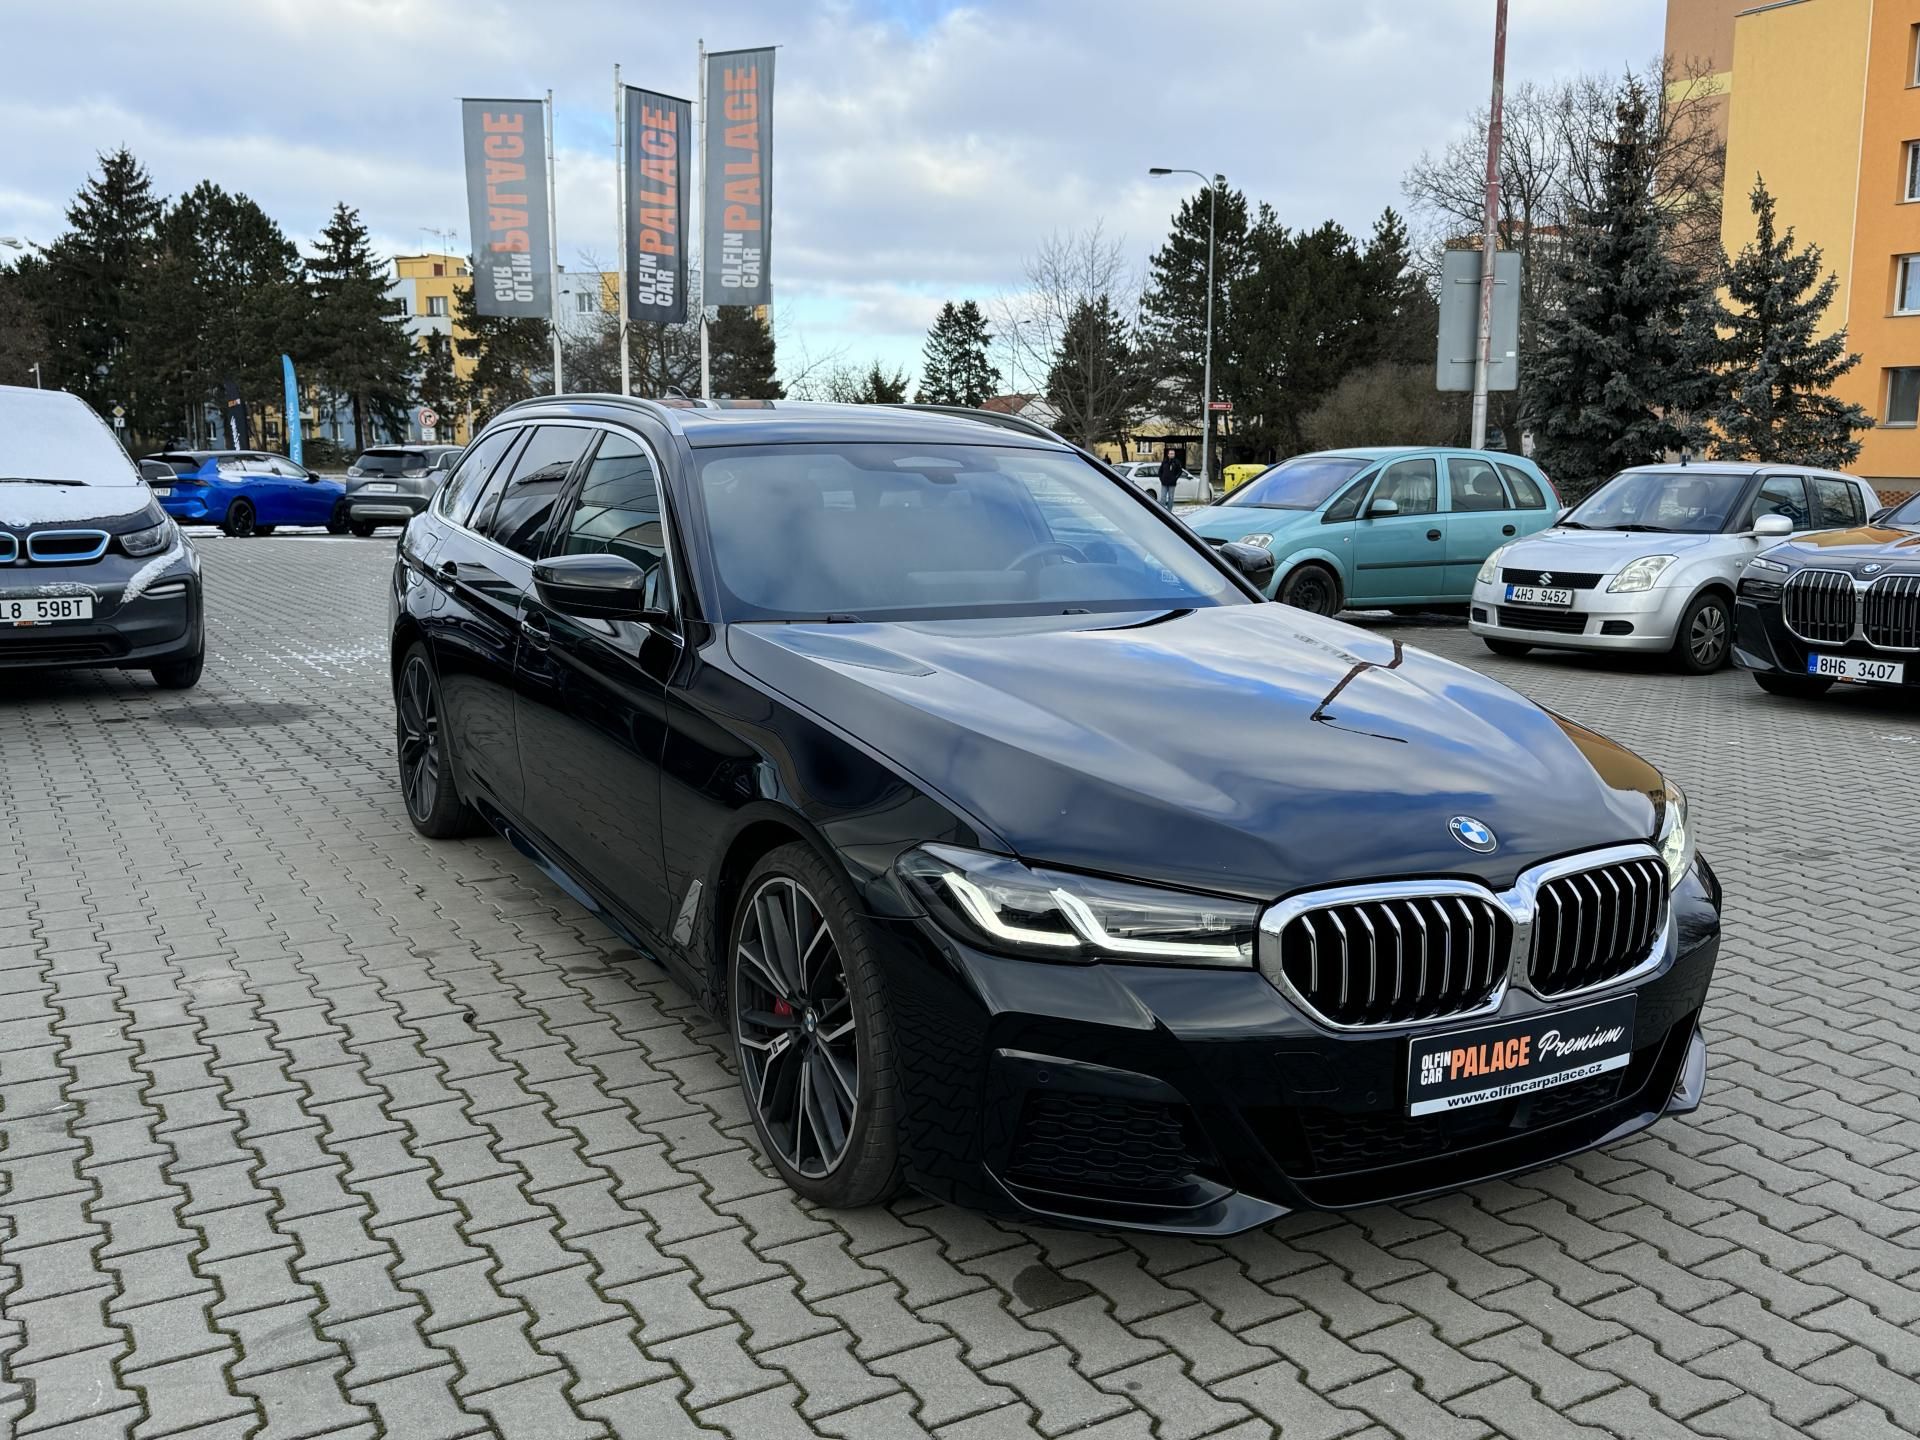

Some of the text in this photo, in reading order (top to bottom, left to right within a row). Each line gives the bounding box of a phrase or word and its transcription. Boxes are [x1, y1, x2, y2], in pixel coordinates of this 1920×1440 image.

[723, 64, 761, 230] PALACE
[639, 106, 676, 256] PALACE
[639, 253, 656, 304] OLFIN
[721, 233, 743, 287] OLFIN
[742, 248, 760, 287] CAR
[656, 269, 674, 306] CAR
[37, 600, 83, 618] 59BT
[1514, 588, 1567, 603] 4H3 9452
[1820, 658, 1895, 679] 8H6 3407
[1421, 1050, 1452, 1071] OLFIN
[1450, 1025, 1625, 1080] PALACE Premium
[1420, 1068, 1443, 1085] CAR
[1447, 1063, 1602, 1107] www.olfincarpalace.cz
